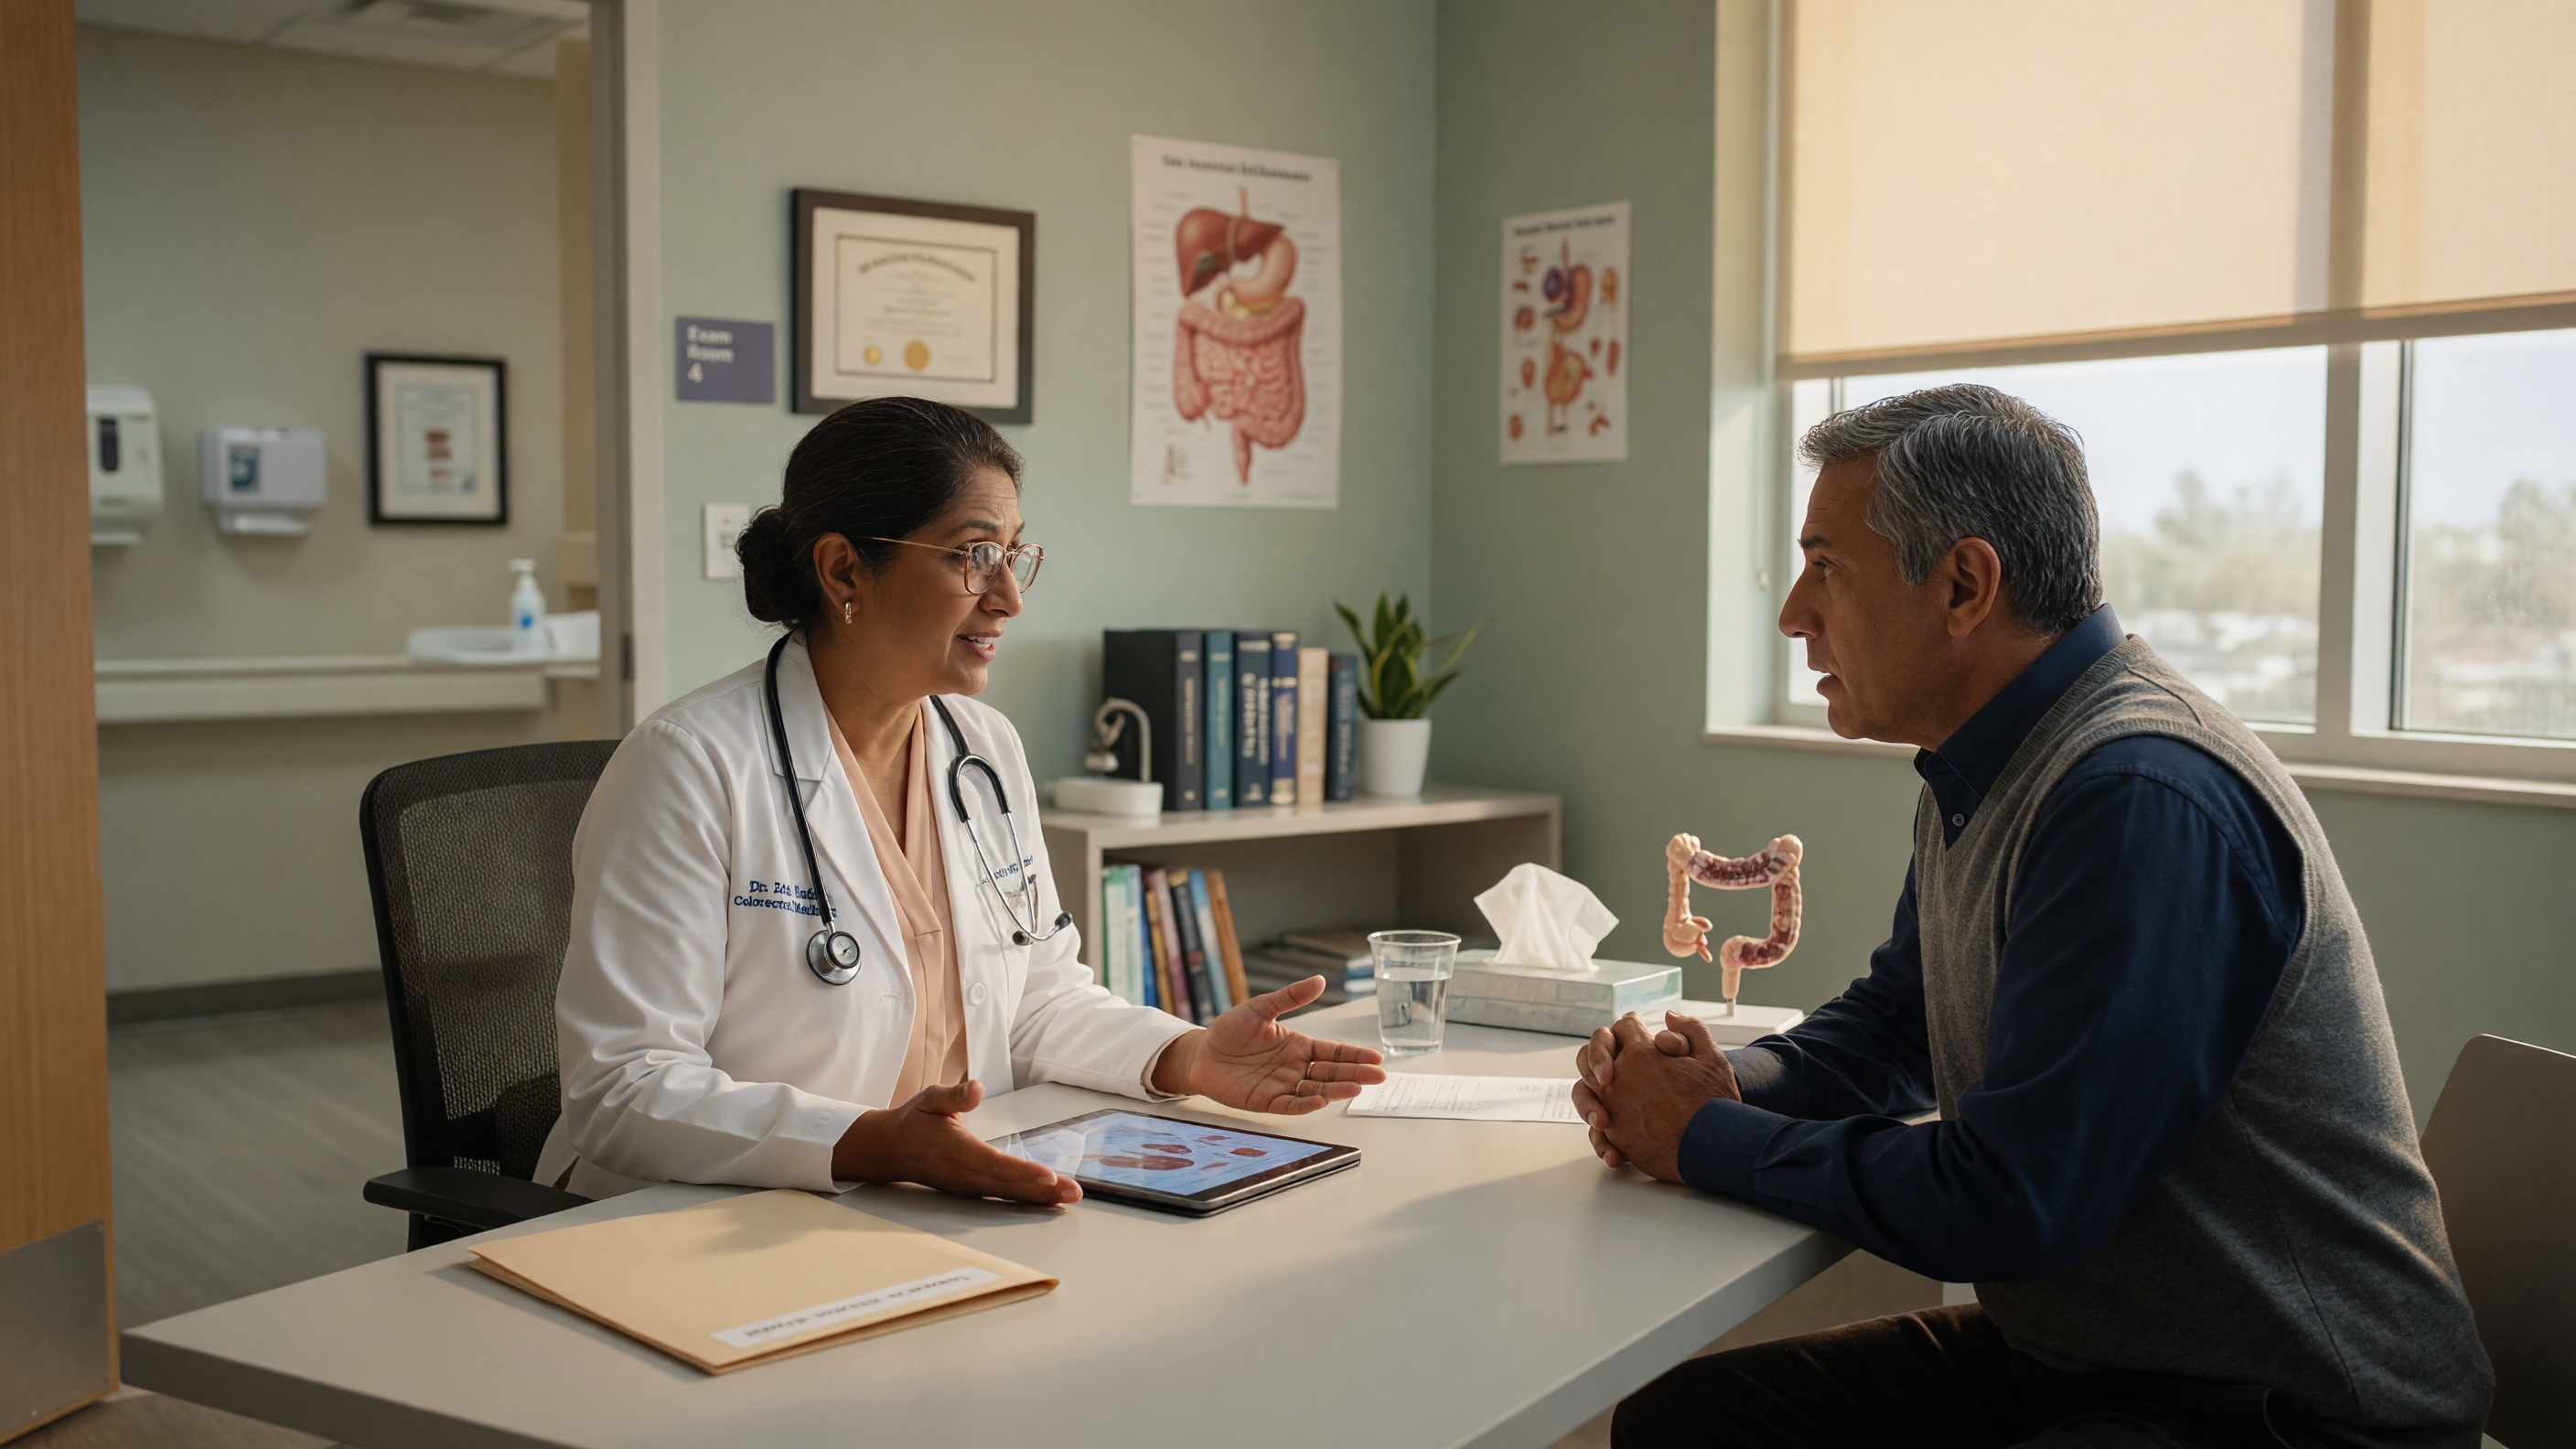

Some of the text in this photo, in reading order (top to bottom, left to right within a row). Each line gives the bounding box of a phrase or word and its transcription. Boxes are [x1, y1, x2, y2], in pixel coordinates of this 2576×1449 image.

[687, 325, 733, 345] Exam
[687, 344, 735, 363] Room
[687, 362, 704, 383] 4
